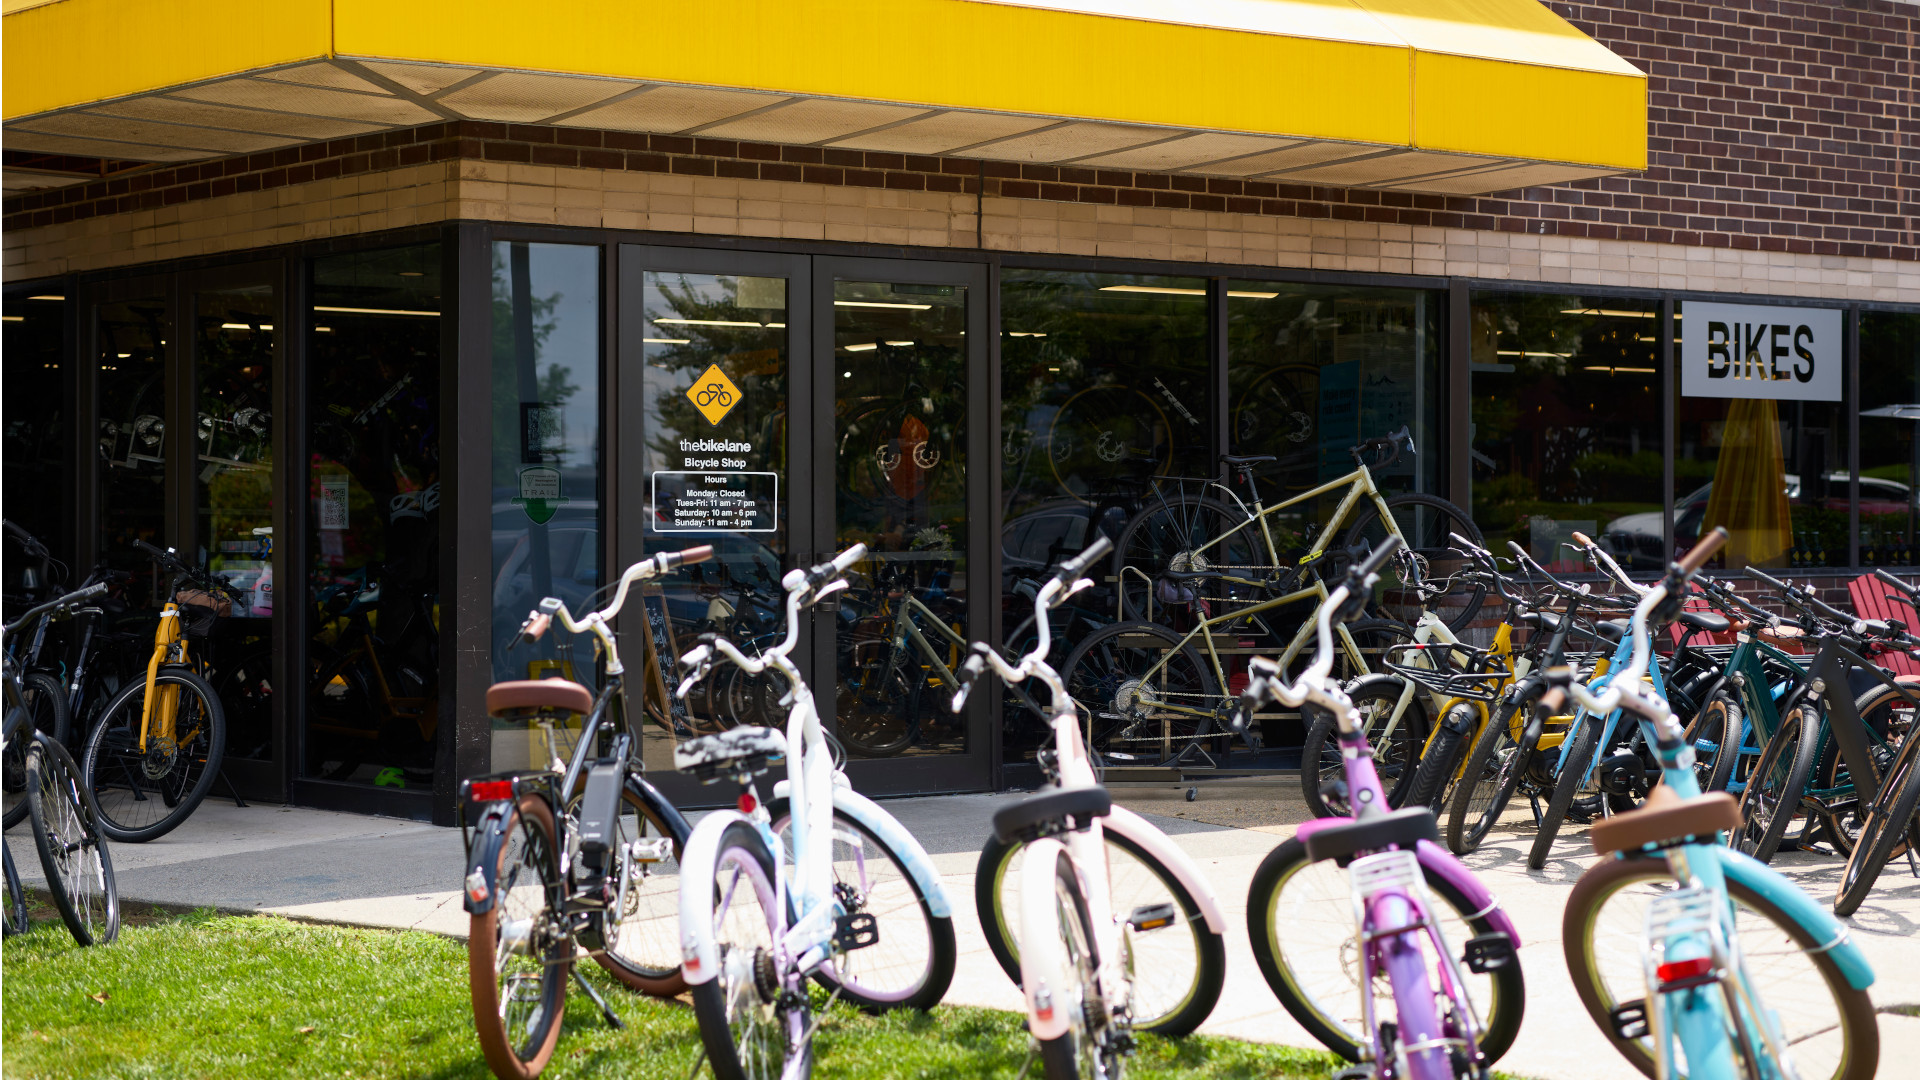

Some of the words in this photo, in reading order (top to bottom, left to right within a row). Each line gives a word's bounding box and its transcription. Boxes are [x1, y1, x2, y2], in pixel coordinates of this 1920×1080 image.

[1708, 321, 1815, 383] BIKES
[352, 370, 414, 425] TREK
[1153, 376, 1200, 427] TREK
[680, 438, 752, 452] thebikelane
[684, 458, 719, 469] Bicycle
[721, 458, 746, 469] Shop
[686, 490, 718, 498] Monday:
[676, 499, 708, 507] Tues-Fri:
[709, 499, 718, 507] 11
[737, 499, 741, 507] 7
[743, 500, 755, 508] pm
[674, 509, 710, 518] Saturday:
[711, 509, 720, 517] 10
[738, 509, 744, 517] 6
[745, 510, 757, 518] pm
[674, 519, 706, 527] Sunday:
